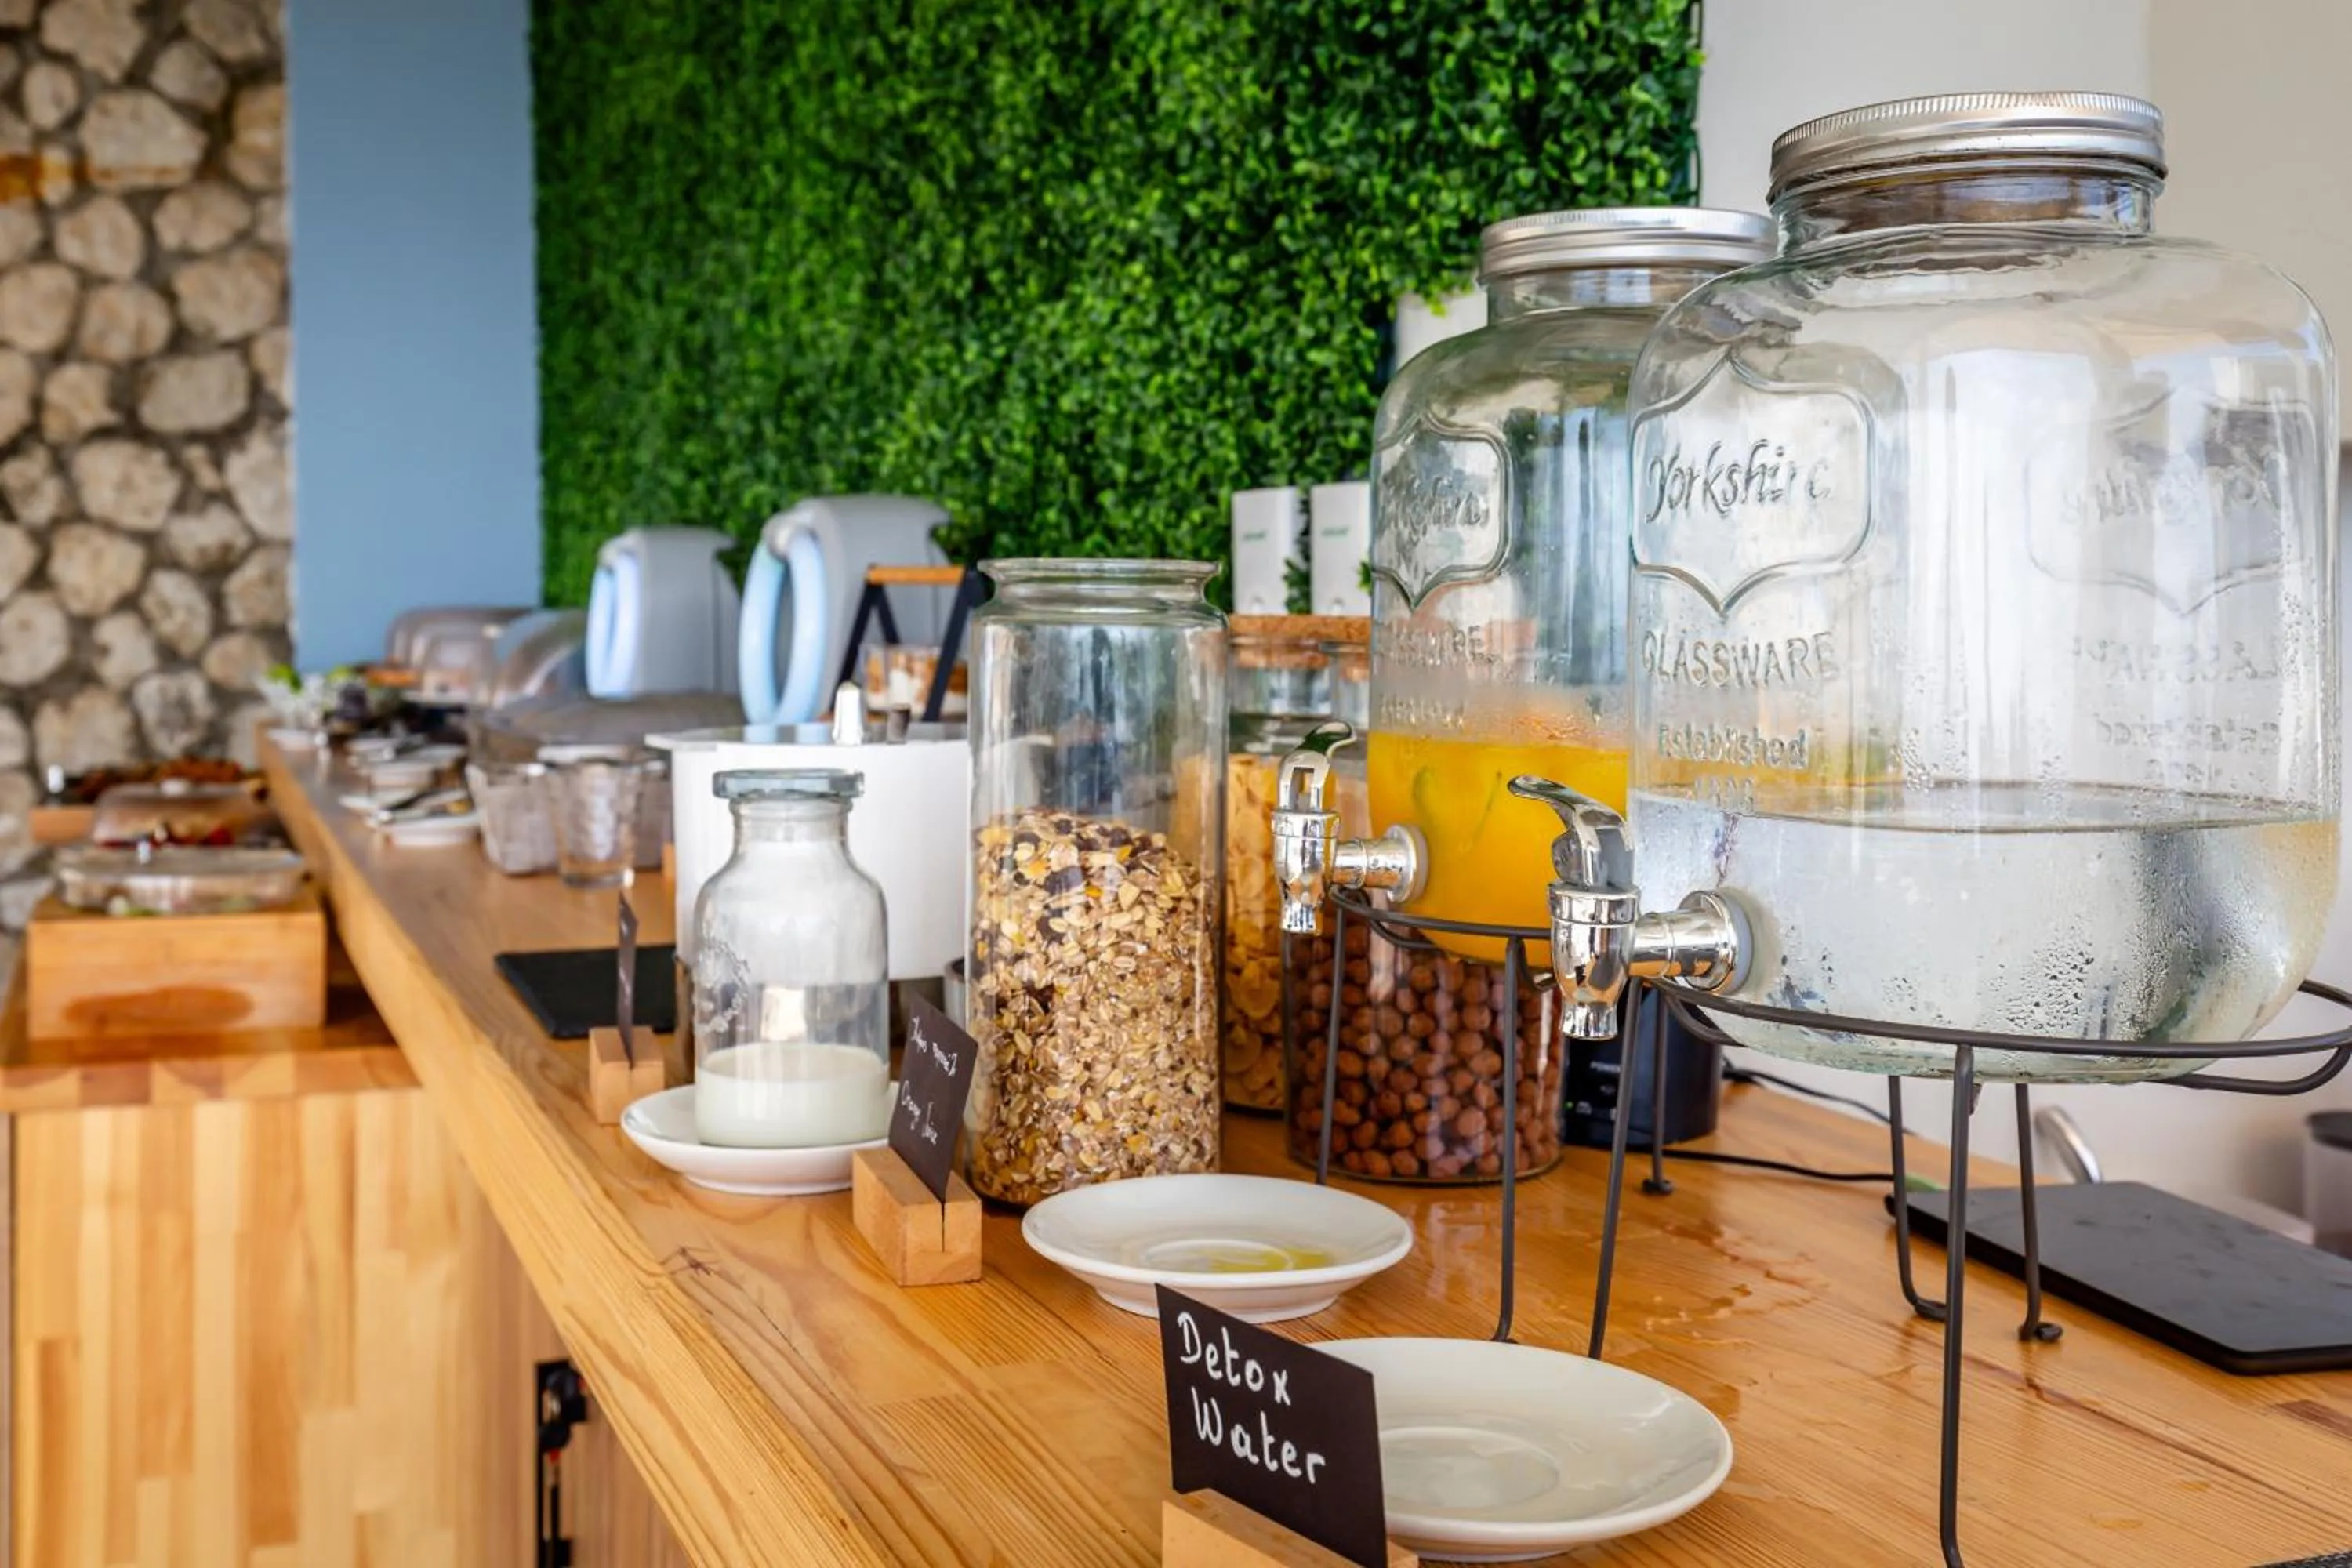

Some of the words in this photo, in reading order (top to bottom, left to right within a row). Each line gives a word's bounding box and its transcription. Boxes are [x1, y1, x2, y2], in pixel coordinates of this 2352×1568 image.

[1645, 438, 1833, 524] Yorkshire
[1642, 630, 1841, 689] GLASSWARE
[1657, 723, 1809, 769] Established
[1177, 1311, 1291, 1406] Detox
[1191, 1385, 1327, 1484] Water
